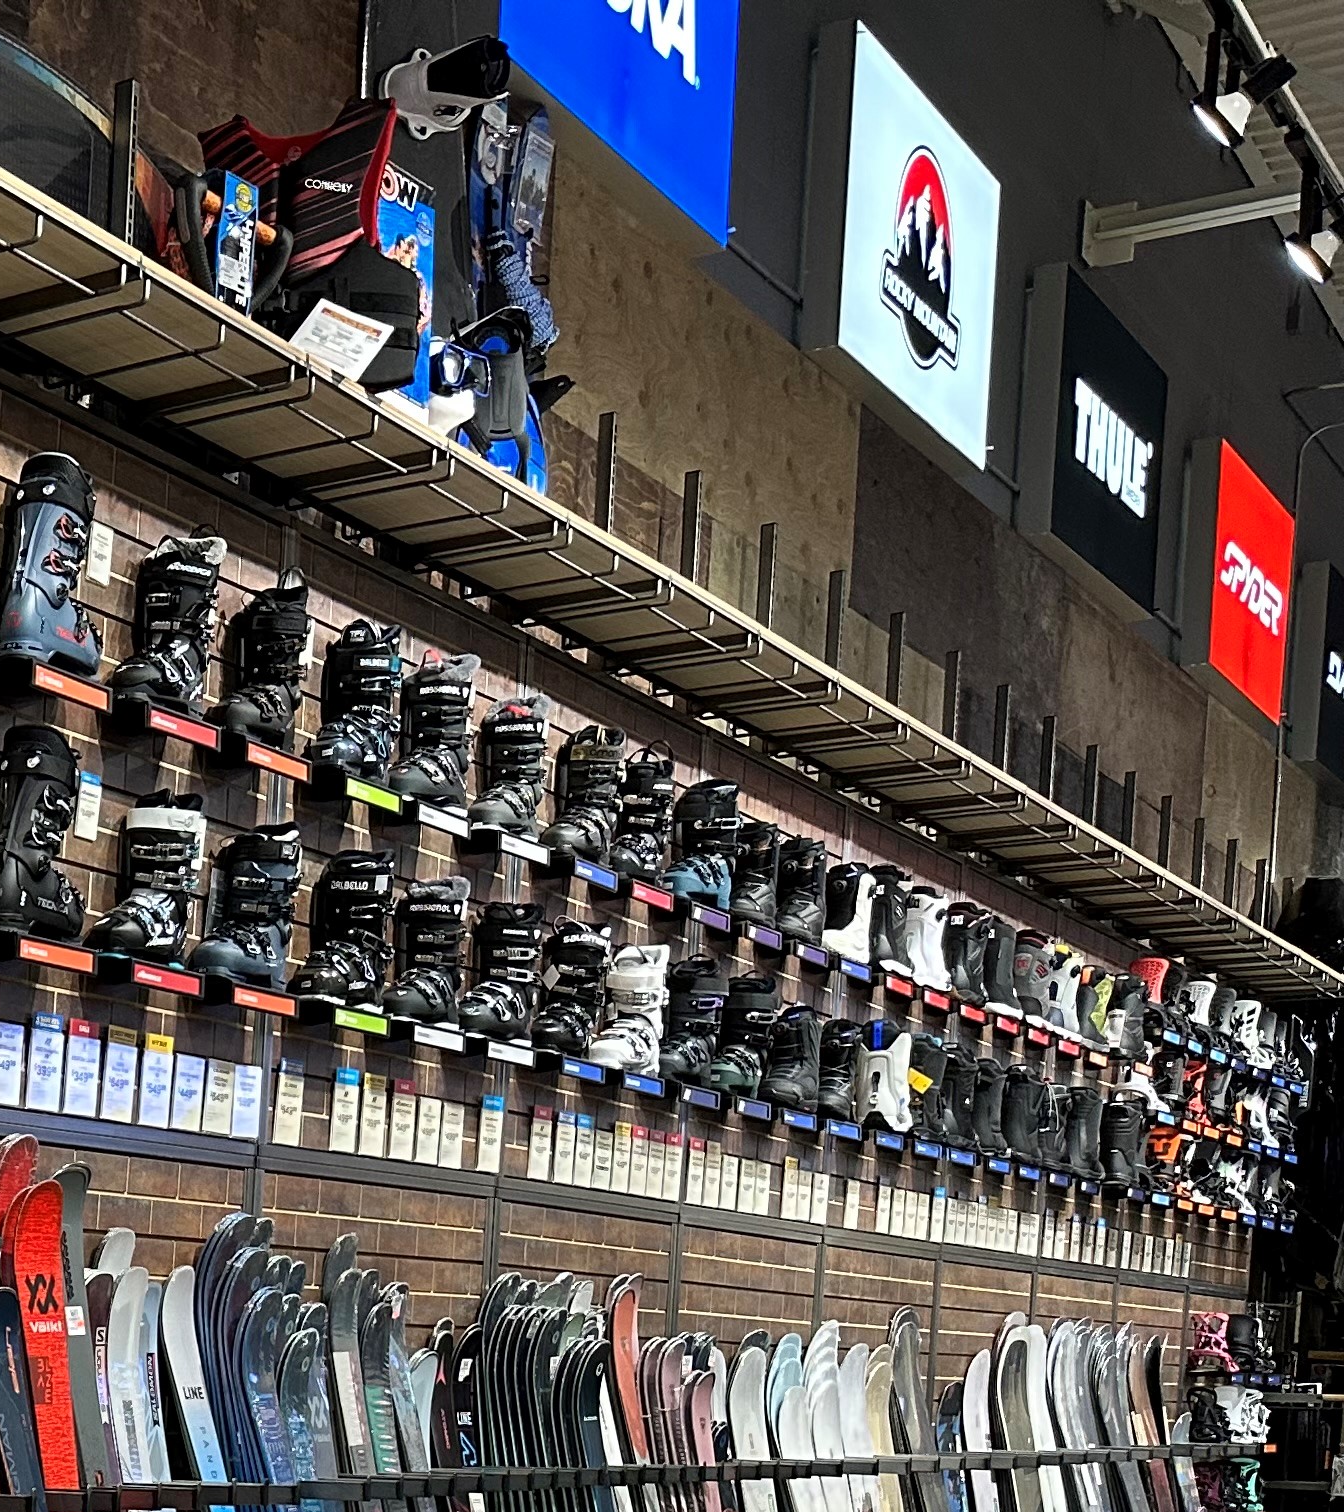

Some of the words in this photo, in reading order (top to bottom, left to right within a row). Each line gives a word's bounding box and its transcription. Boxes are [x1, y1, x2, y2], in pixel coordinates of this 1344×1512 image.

[884, 266, 916, 312] ROCKY
[913, 294, 958, 354] MOUNTAIN
[1074, 377, 1149, 519] THULE
[1219, 541, 1283, 636] SPYDER
[28, 1319, 64, 1334] Völkl
[182, 1385, 206, 1401] LINE
